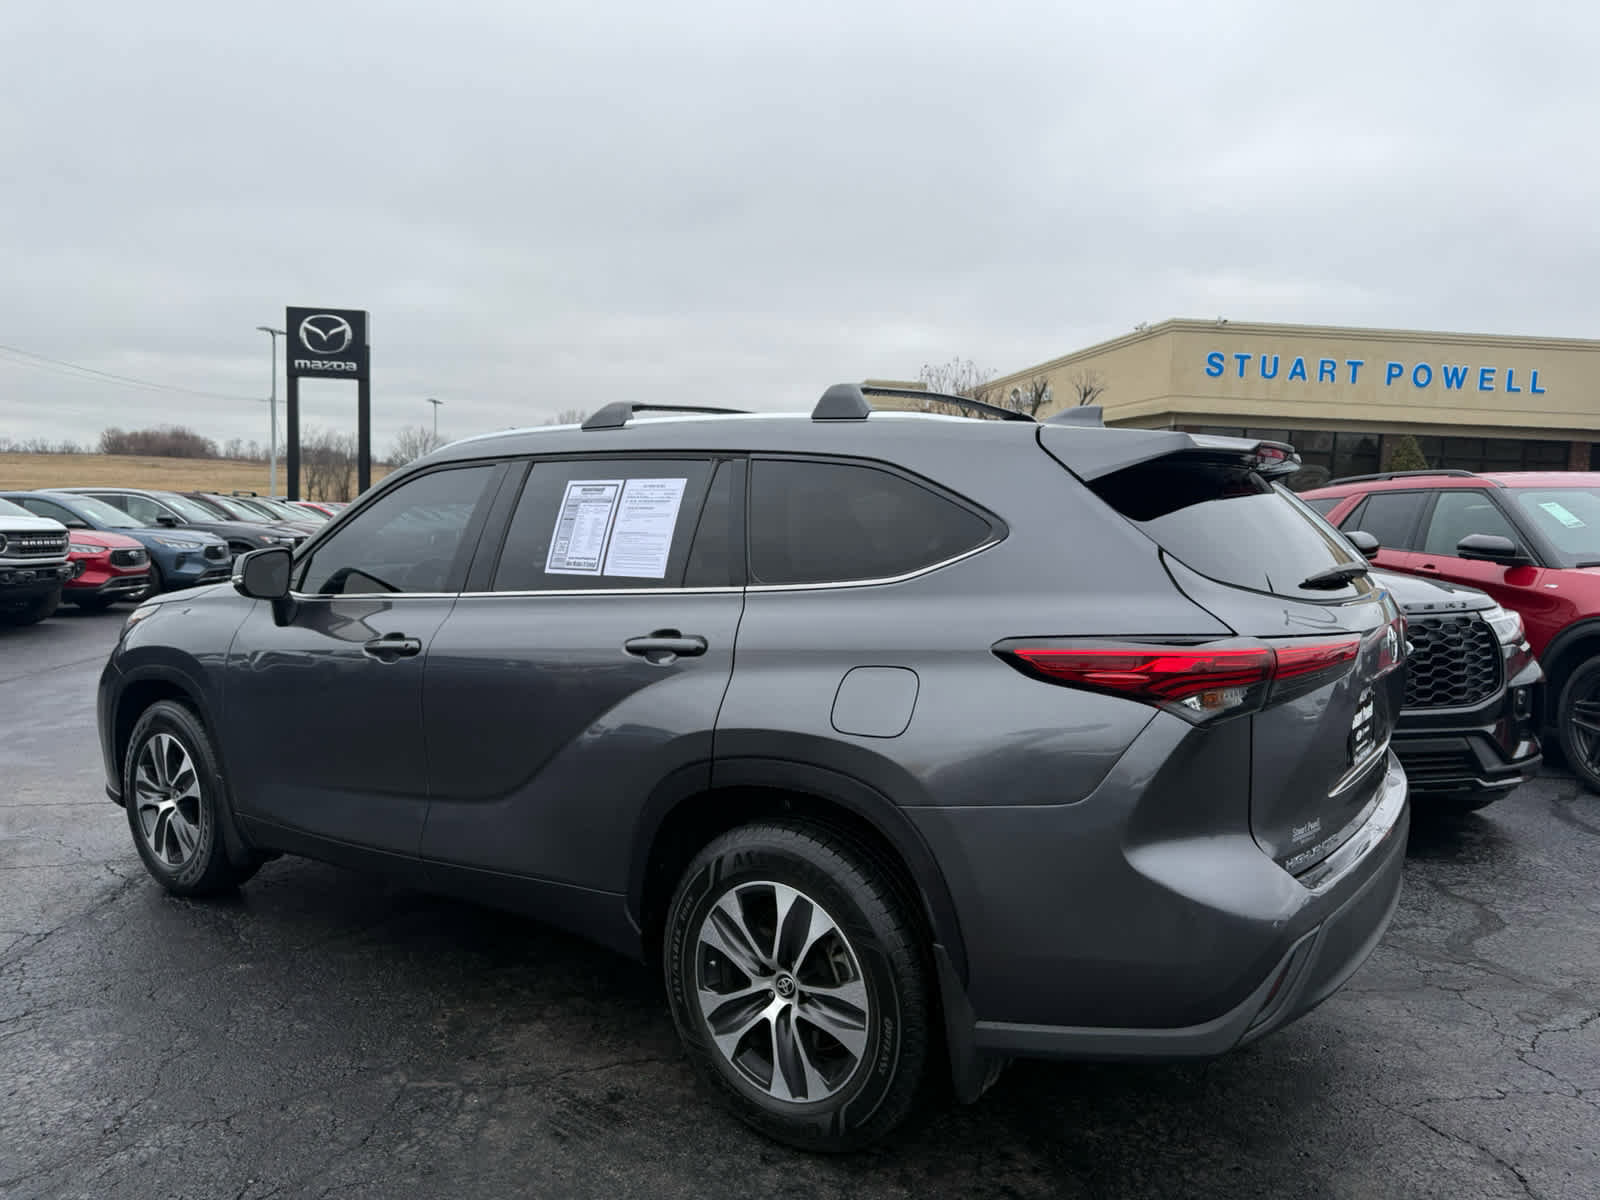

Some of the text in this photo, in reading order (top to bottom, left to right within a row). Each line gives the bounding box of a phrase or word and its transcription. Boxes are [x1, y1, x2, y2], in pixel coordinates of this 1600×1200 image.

[294, 359, 358, 371] mazda
[1205, 352, 1547, 395] STUART POWELL
